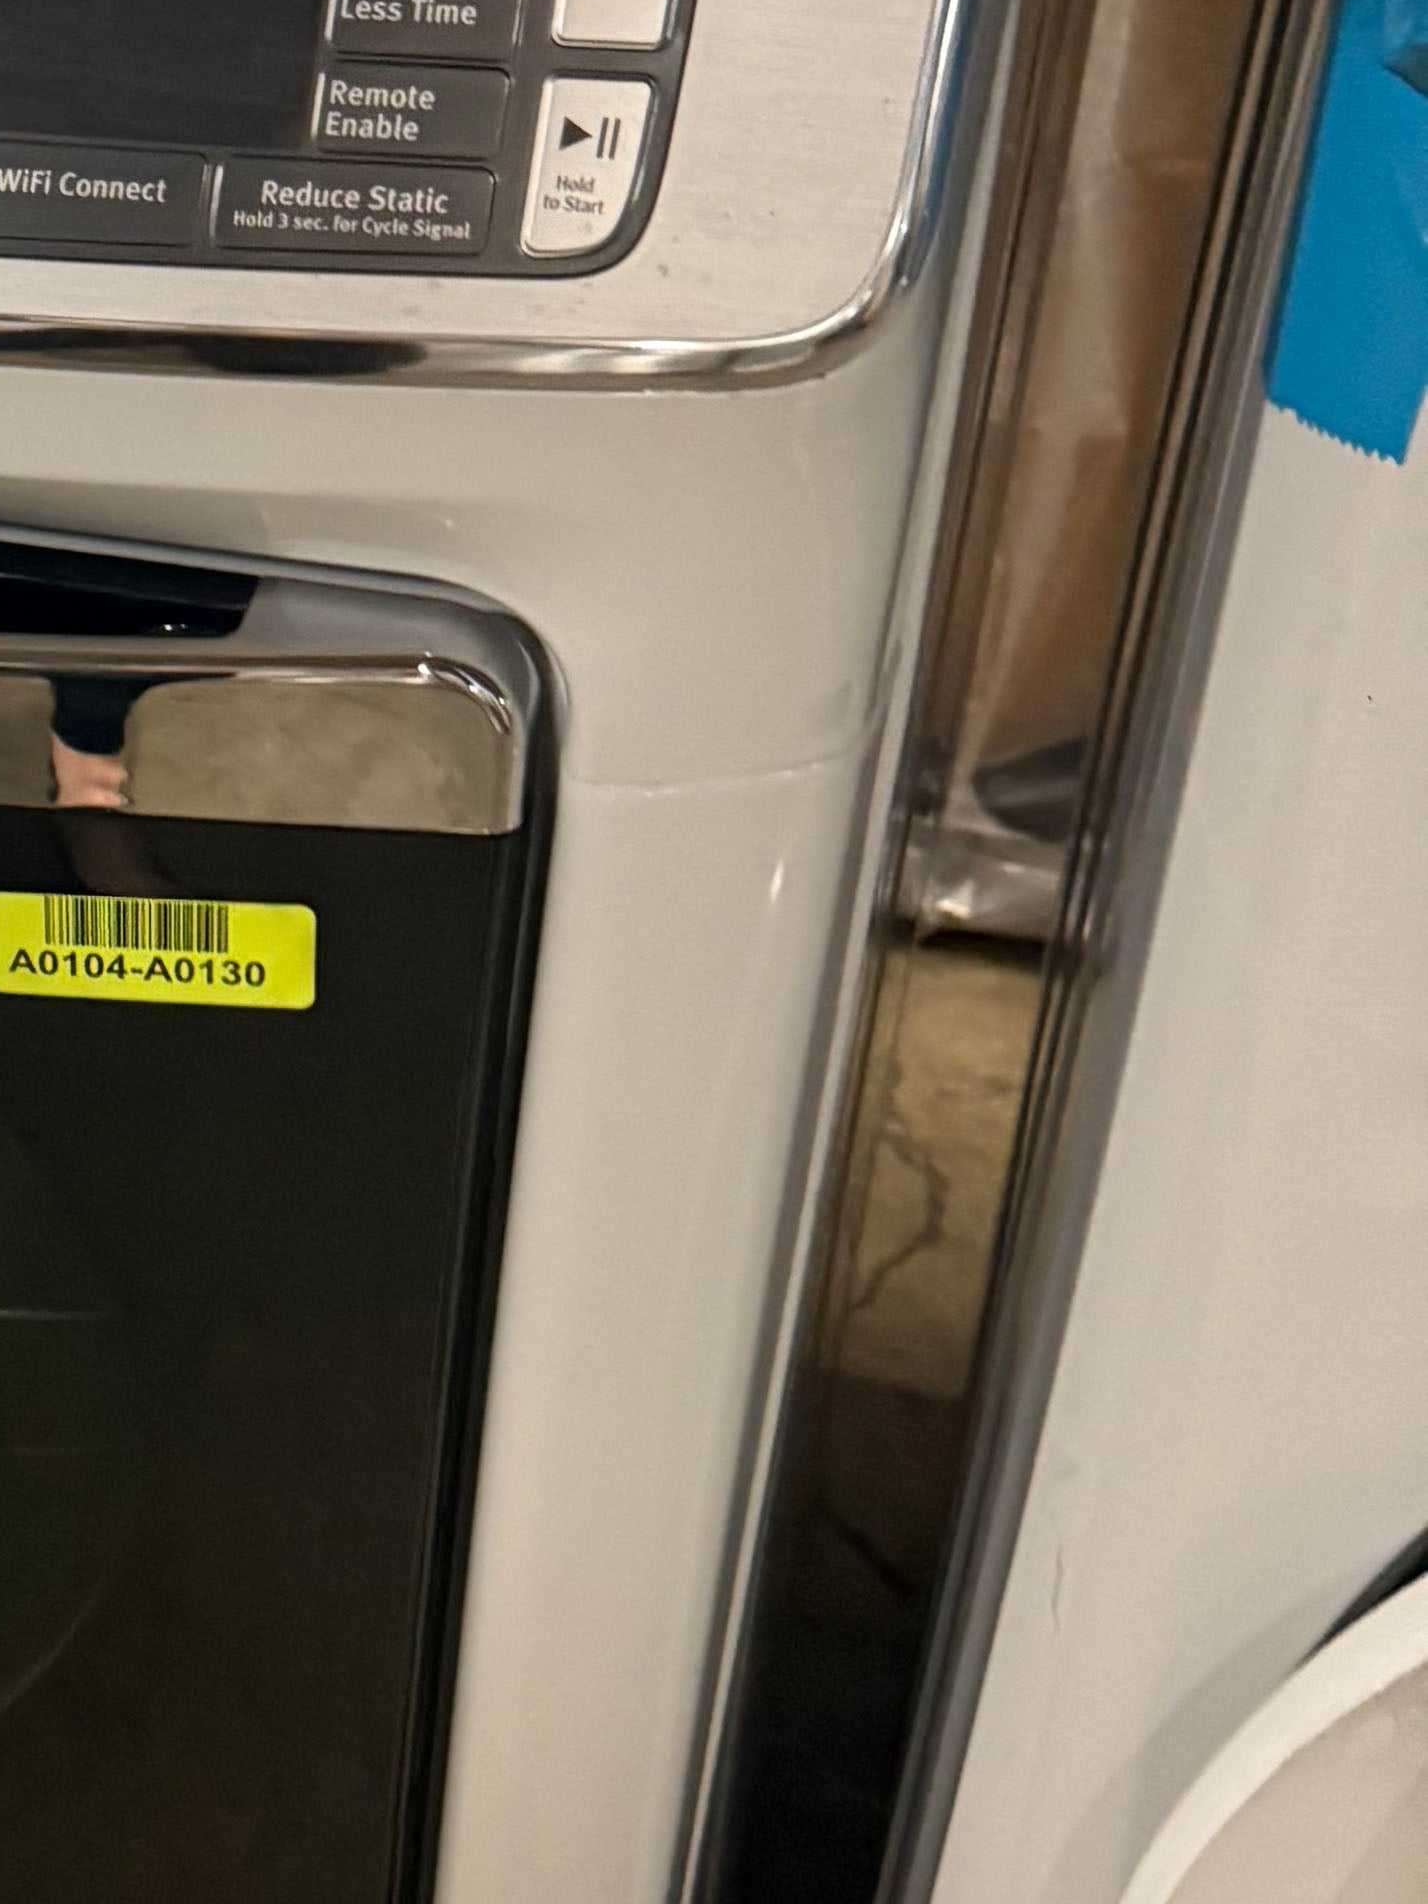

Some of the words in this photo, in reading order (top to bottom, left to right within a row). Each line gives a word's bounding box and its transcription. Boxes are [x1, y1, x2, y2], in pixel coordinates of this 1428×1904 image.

[329, 79, 435, 111] Remote
[325, 111, 420, 142] Enable
[59, 172, 167, 203] Connect
[260, 180, 361, 209] Reduce
[367, 184, 450, 214] Static
[556, 175, 596, 193] Hold
[544, 196, 560, 211] to
[563, 196, 605, 215] Start
[233, 210, 274, 229] Hold
[277, 212, 289, 229] 3
[293, 214, 329, 232] sec.
[332, 214, 359, 233] for
[362, 215, 410, 238] Cycle
[411, 218, 471, 241] Signal
[8, 948, 266, 988] A0104-A0130
